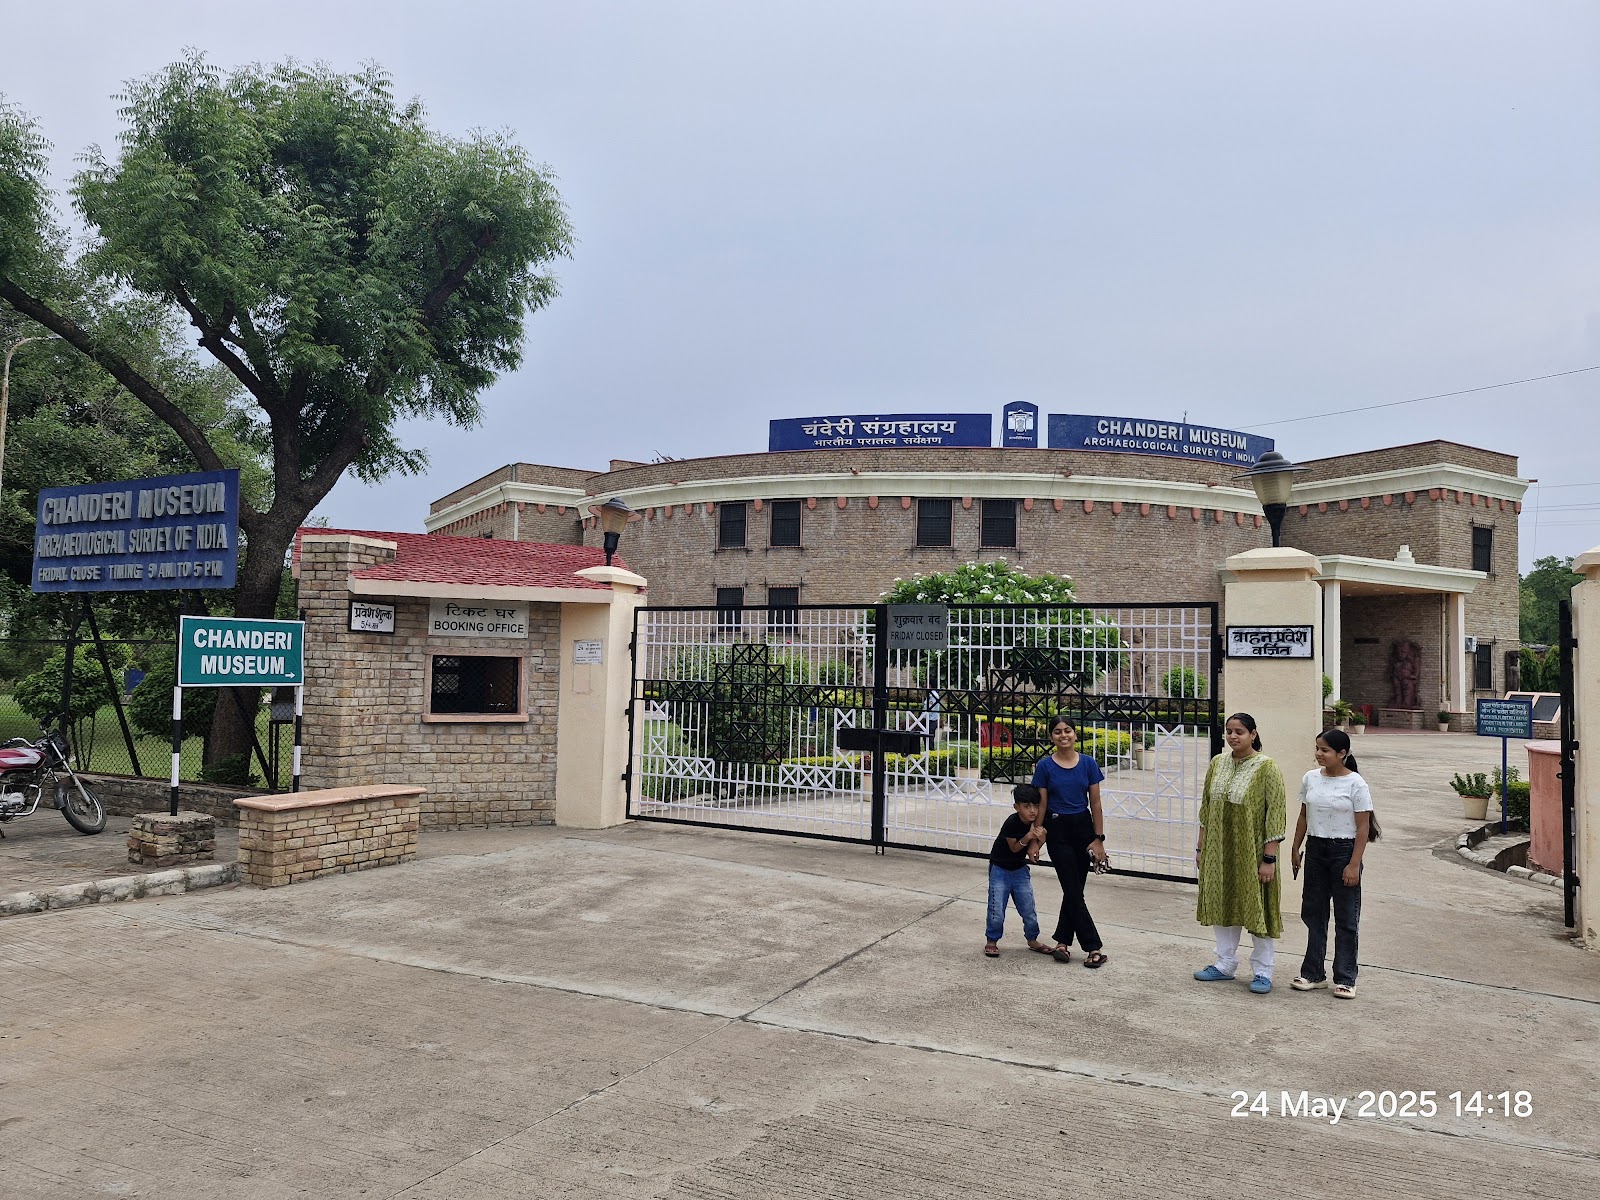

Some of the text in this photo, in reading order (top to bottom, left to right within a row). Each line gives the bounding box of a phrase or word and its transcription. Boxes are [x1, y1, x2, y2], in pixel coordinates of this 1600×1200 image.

[801, 416, 957, 436] चंदेरी संग्रहालय
[1097, 419, 1247, 450] CHANDERI MUSEUM
[814, 436, 853, 447] भारतीय
[1084, 437, 1256, 463] ARCHAEOLOGICAL SURVEY OF INDIA
[42, 482, 225, 524] CHANDERI MUSEUM
[36, 529, 126, 558] ARCHAEOLOGICAL
[129, 527, 172, 553] SURVEY
[175, 525, 192, 551] OF
[38, 567, 69, 581] FRIDAY
[71, 566, 100, 581] CLOSE
[148, 563, 157, 578] 9
[158, 562, 176, 578] AM
[177, 561, 191, 577] TO
[194, 561, 202, 577] 5
[204, 560, 223, 577] PM
[445, 603, 516, 619] टिकट घर
[434, 621, 524, 634] BOOKING OFFICE
[893, 615, 924, 629] शुक्रवार
[891, 631, 944, 641] FRIDAY CLOSED
[1232, 628, 1308, 646] वाहन प्रवेश
[193, 628, 292, 675] CHANDERI MUSEUM
[1251, 643, 1291, 655] वर्जित
